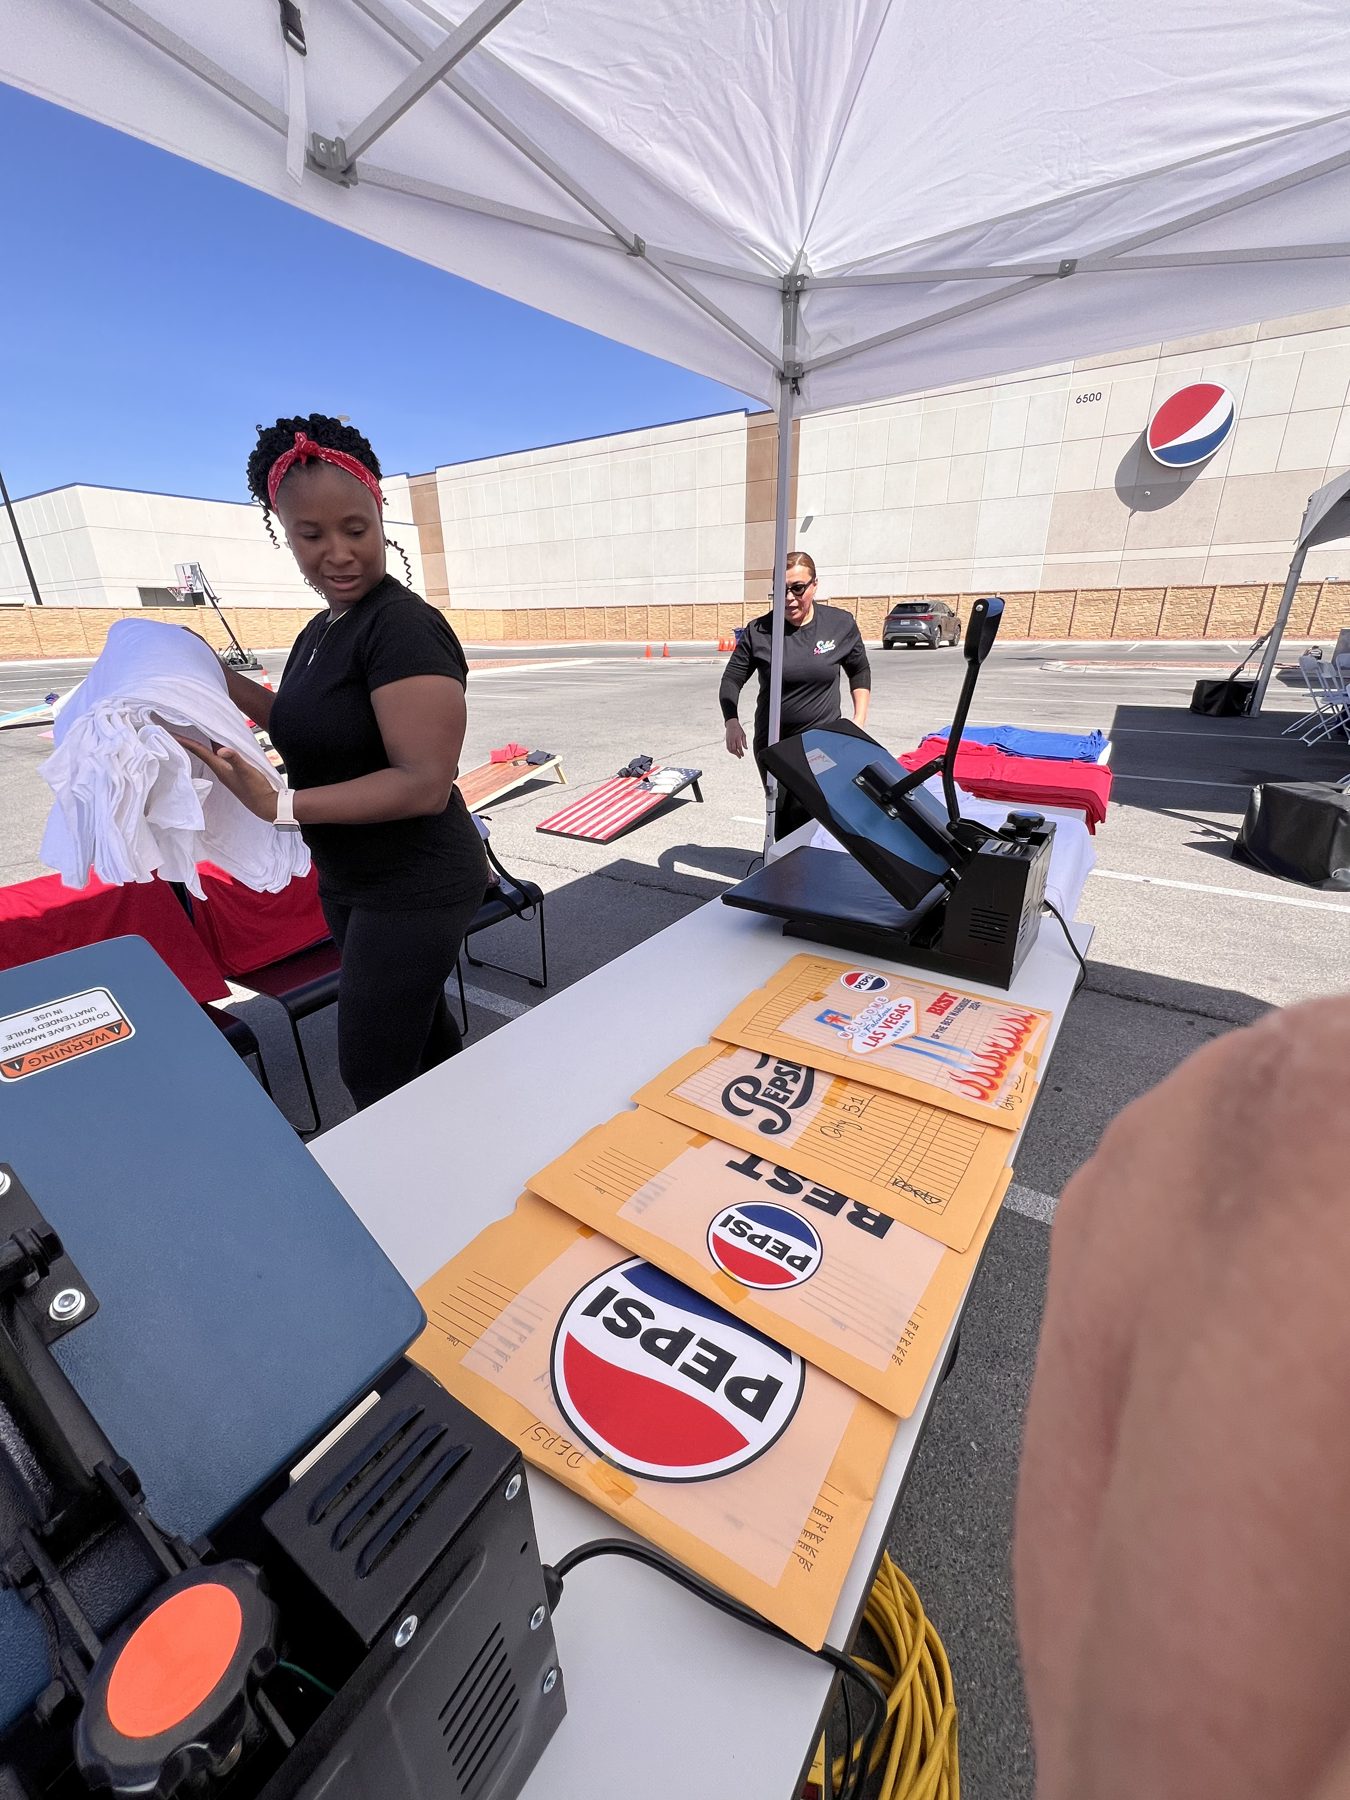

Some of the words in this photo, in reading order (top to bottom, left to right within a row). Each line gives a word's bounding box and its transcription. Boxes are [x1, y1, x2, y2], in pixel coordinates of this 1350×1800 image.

[1075, 392, 1102, 404] 6500
[853, 973, 876, 990] PEPSI
[925, 991, 959, 1016] BEST
[33, 1011, 53, 1022] USE
[37, 1006, 97, 1030] UNATTENDED
[78, 1015, 96, 1026] NOT
[96, 1011, 110, 1020] DO
[839, 996, 888, 1038] WELCOME
[6, 1026, 37, 1041] WHILE
[48, 1022, 77, 1036] LEAVE
[862, 1030, 887, 1048] LAS
[878, 1003, 912, 1032] VEGAS
[1, 1034, 47, 1053] MACHINE
[28, 1032, 110, 1067] WARNING
[718, 1214, 813, 1273] PEPSI
[580, 1285, 784, 1423] PEPSI
